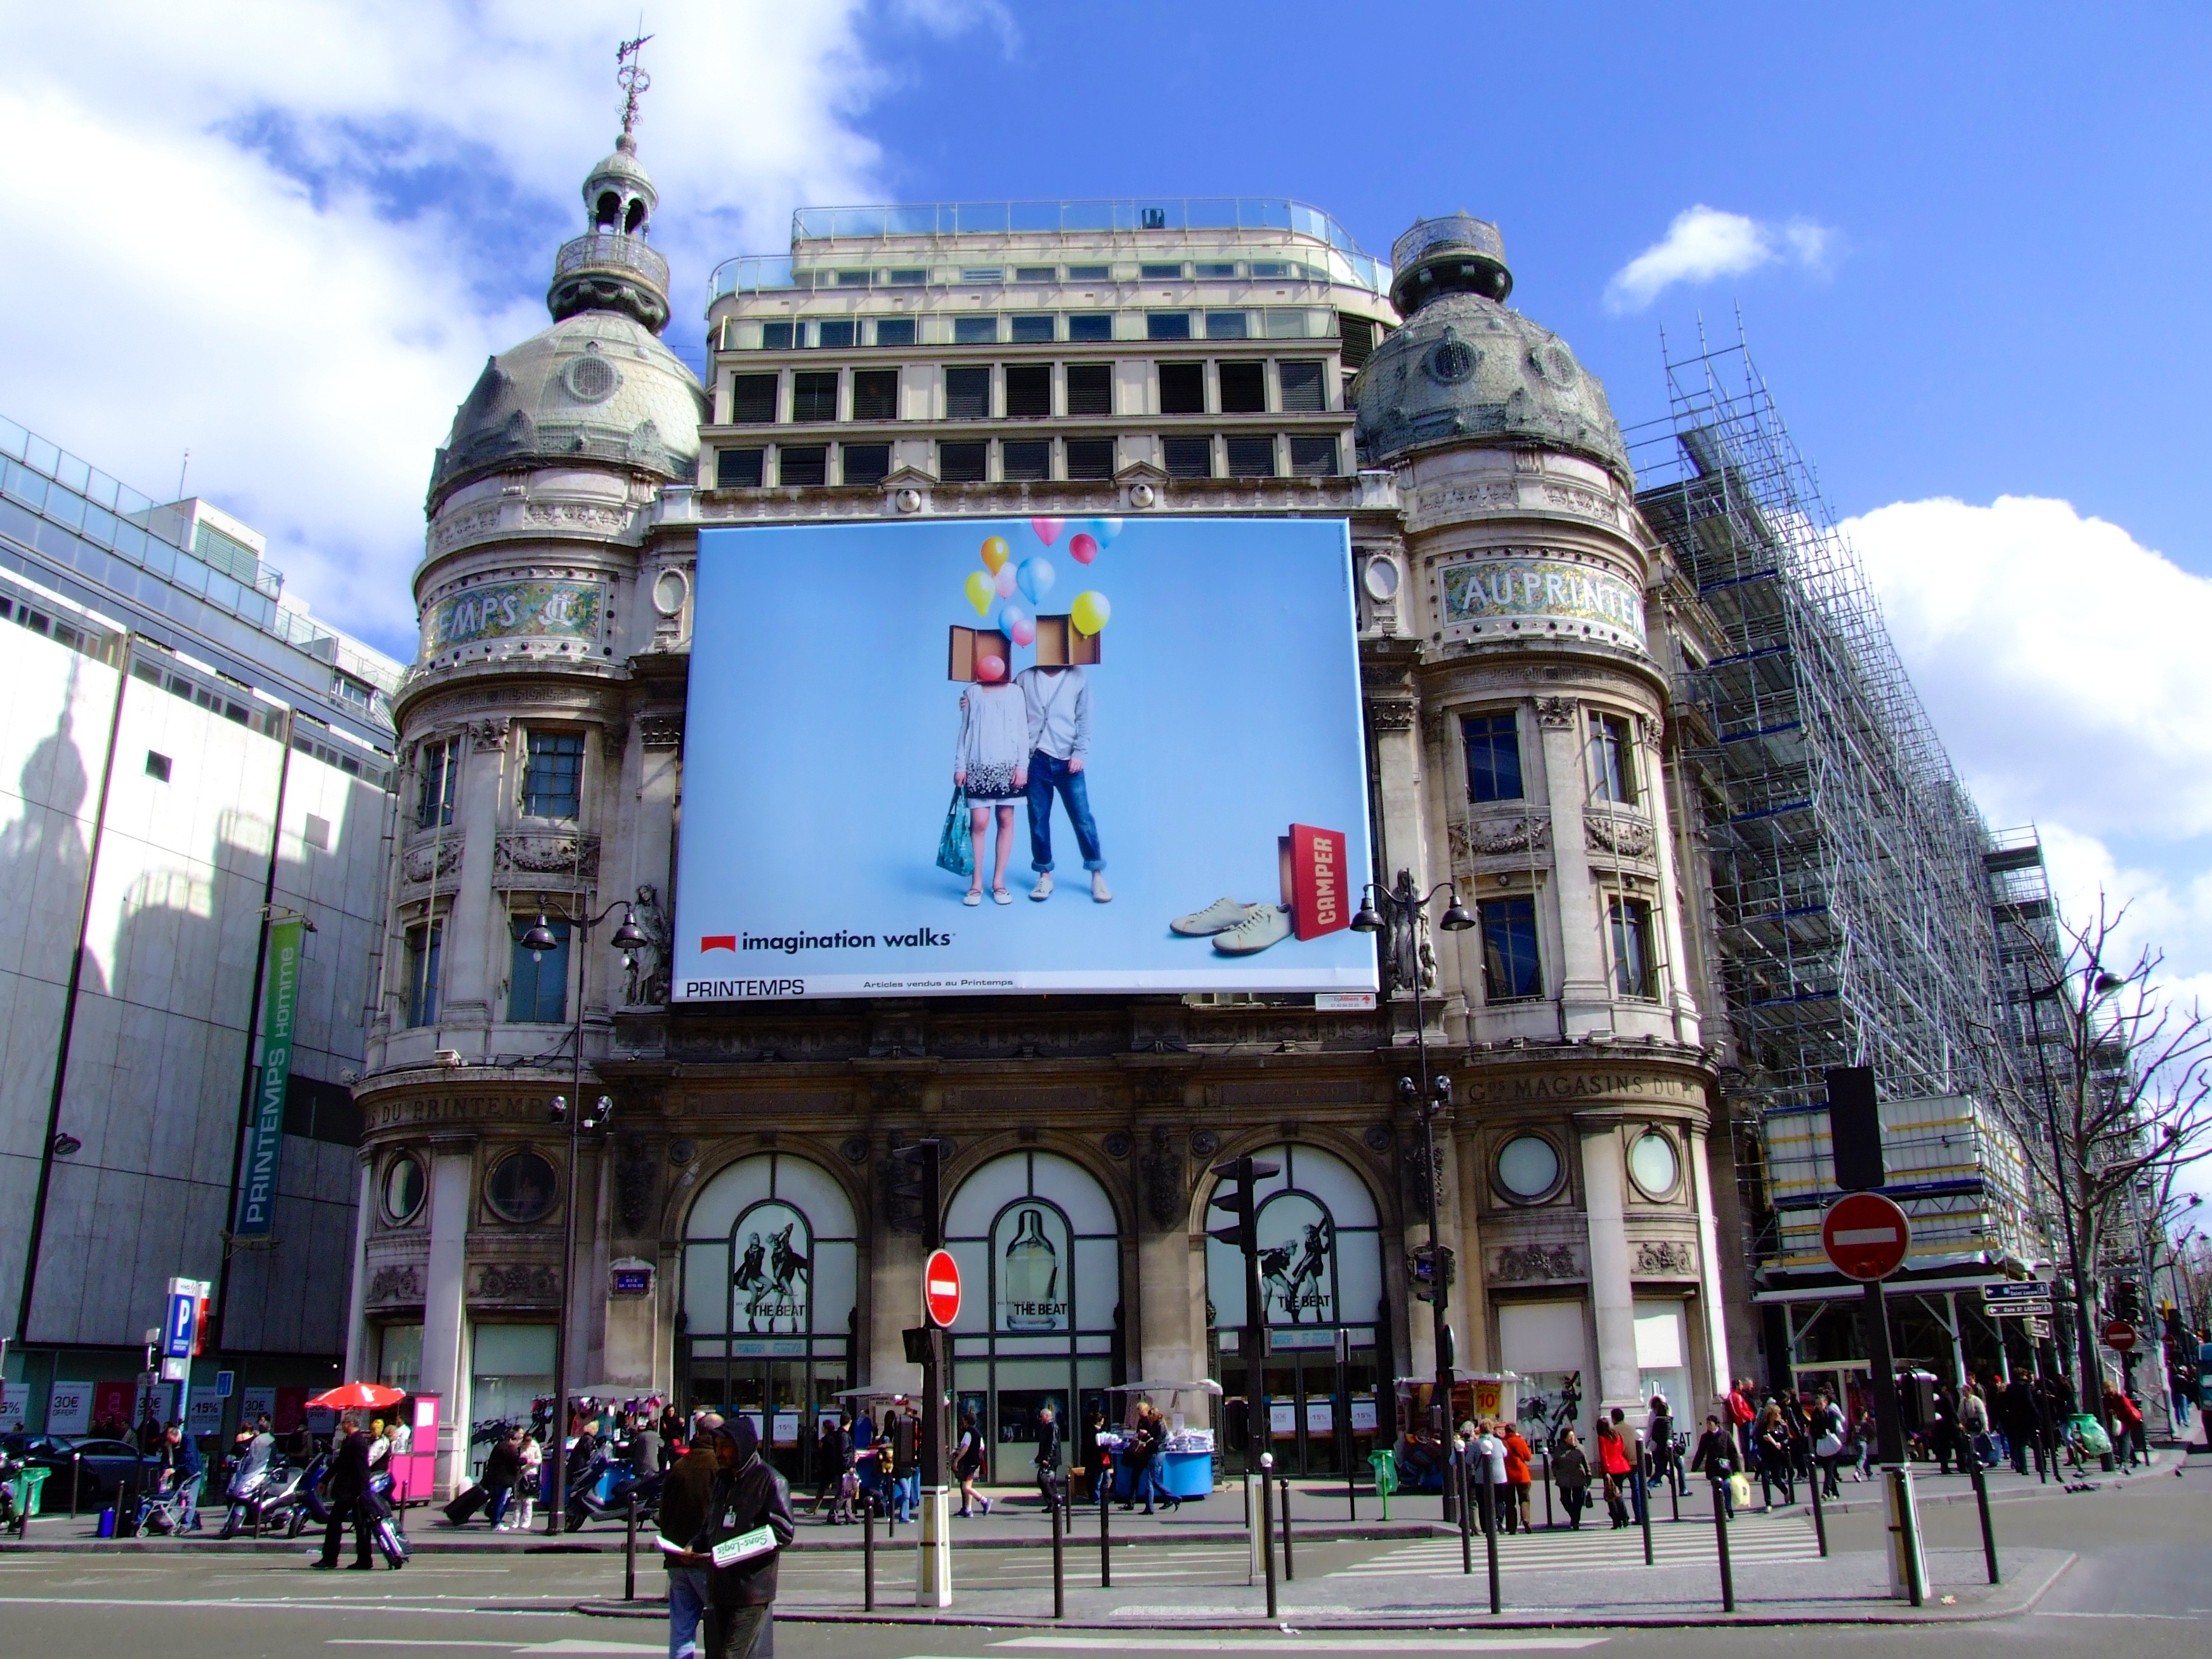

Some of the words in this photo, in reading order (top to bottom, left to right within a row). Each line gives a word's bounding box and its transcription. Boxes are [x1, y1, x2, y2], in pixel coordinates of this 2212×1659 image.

[1462, 573, 1513, 610] AU
[1313, 836, 1337, 926] CAMPER
[742, 930, 876, 954] imagination
[686, 979, 805, 998] PRINTEMPS
[1514, 1074, 1644, 1098] MAGASINS
[1654, 1077, 1676, 1096] DU
[382, 1102, 402, 1123] DU
[413, 1097, 544, 1122] PRINTEMP
[246, 1048, 286, 1223] PRINTEMPS
[753, 1304, 774, 1317] THE
[776, 1304, 805, 1317] BEAT
[1014, 1303, 1036, 1316] THE
[1038, 1303, 1067, 1315] BEAT
[1277, 1296, 1299, 1308] THE
[1302, 1295, 1330, 1307] BEAT
[177, 1299, 190, 1337] P
[55, 1396, 79, 1409] 30€
[192, 1402, 219, 1414] -15%
